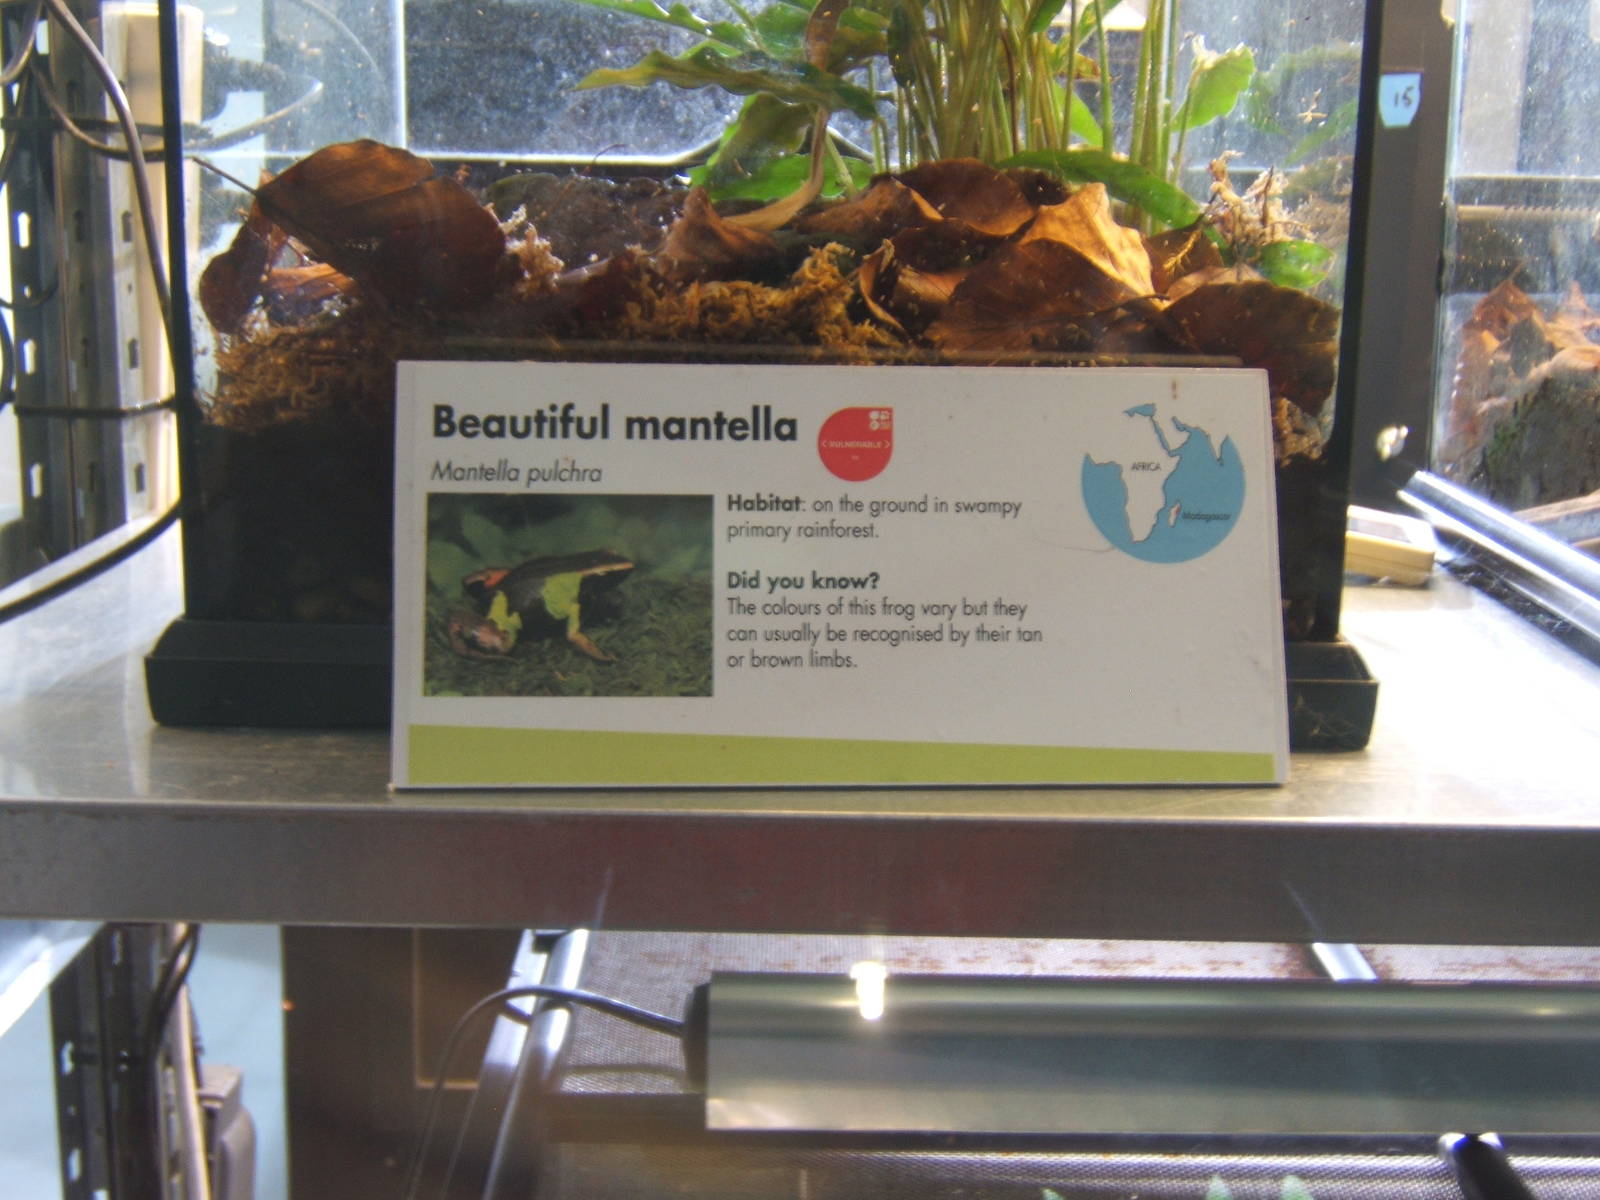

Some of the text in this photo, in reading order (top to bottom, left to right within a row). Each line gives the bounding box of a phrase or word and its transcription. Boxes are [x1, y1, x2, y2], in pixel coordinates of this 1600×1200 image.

[1394, 85, 1414, 108] 15
[432, 404, 798, 442] Beautiful mantella
[431, 460, 603, 487] Mantella pulchra
[1131, 462, 1161, 471] AFRICA
[727, 494, 1022, 517] Habitat: on the ground in swampy
[727, 520, 879, 542] primary rainforest.
[727, 571, 880, 593] Did you know?
[727, 598, 1028, 621] The colours of this frog vary but they
[727, 623, 1043, 647] can usually be recognised by their tan
[727, 649, 857, 668] or brown limbs.
